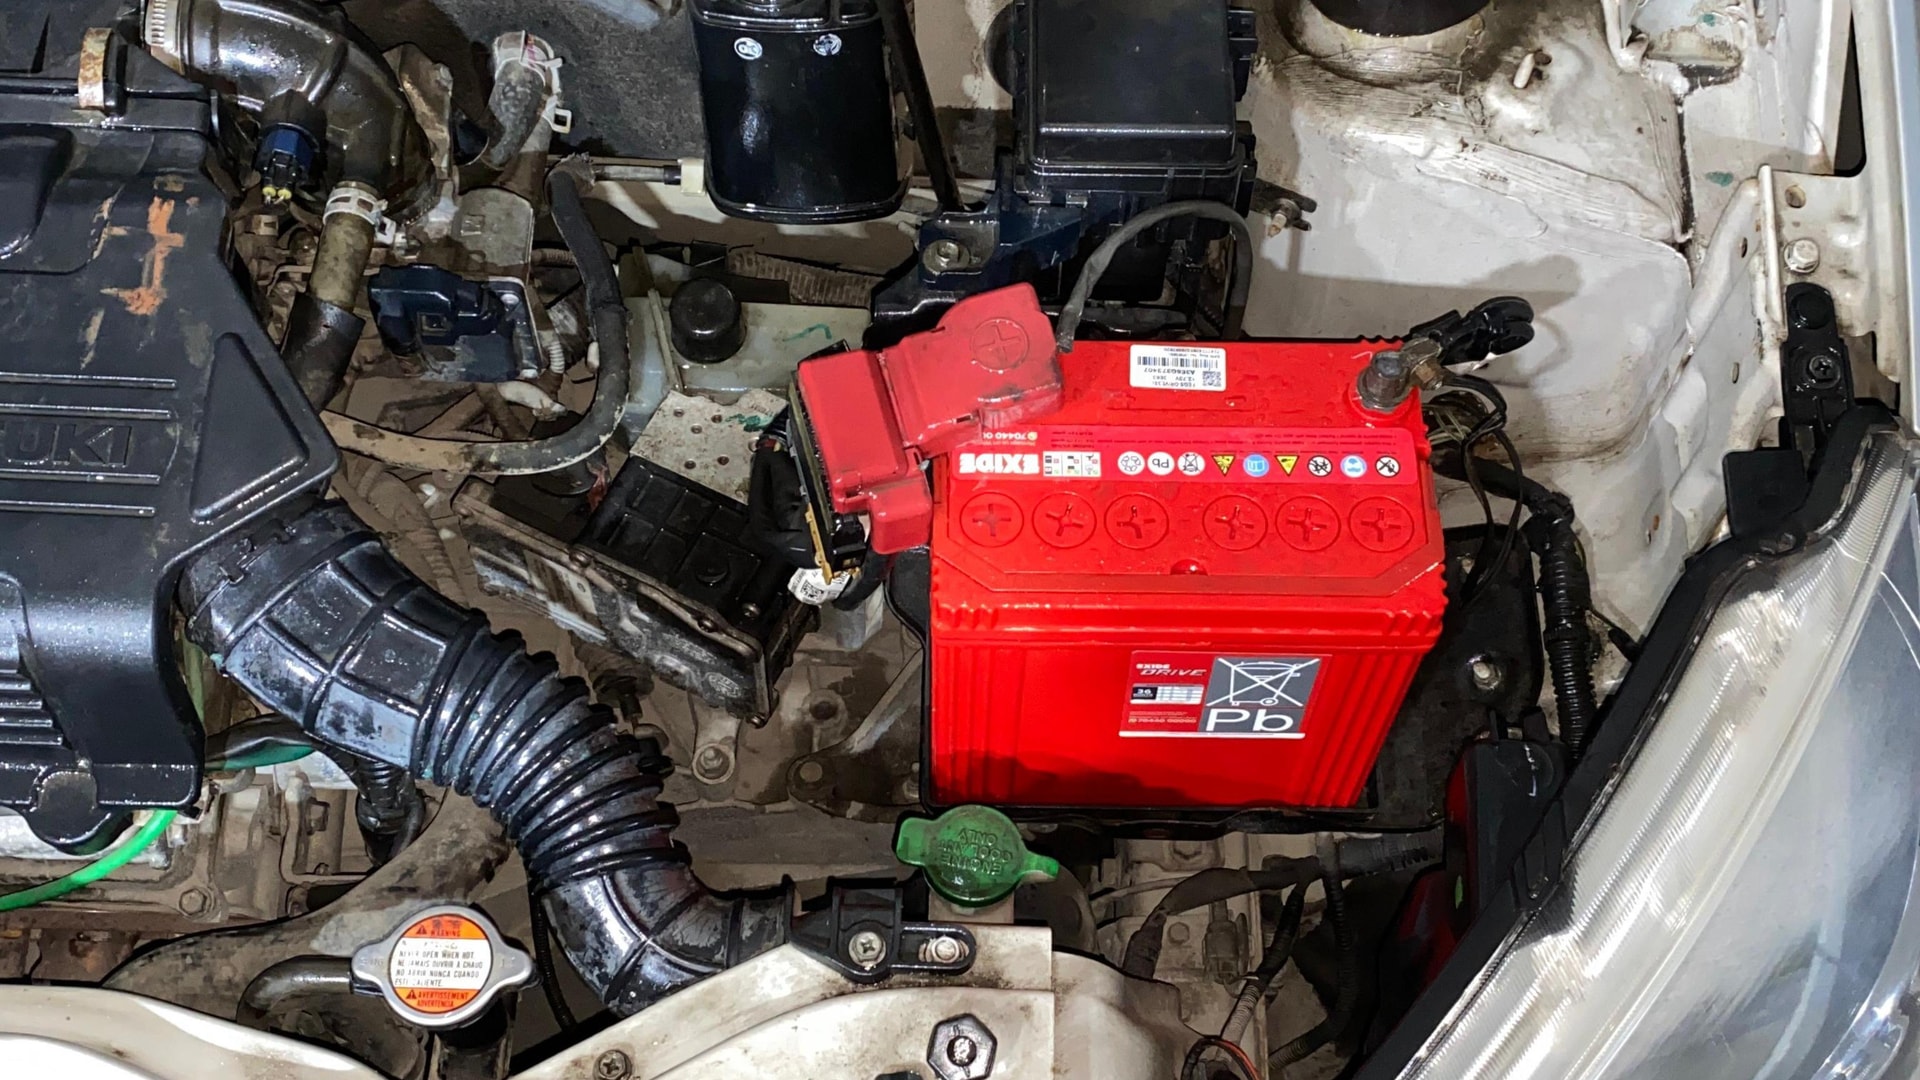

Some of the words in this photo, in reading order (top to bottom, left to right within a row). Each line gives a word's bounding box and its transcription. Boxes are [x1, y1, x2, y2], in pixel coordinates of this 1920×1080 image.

[0, 421, 132, 467] UKI
[959, 453, 1041, 475] EXIDE
[1152, 457, 1170, 470] Pb
[1205, 708, 1293, 732] Pb
[958, 828, 998, 847] ONLY
[937, 839, 1013, 864] COOLANT
[940, 852, 1003, 876] ENGINE
[453, 970, 480, 978] CUANDO
[418, 991, 470, 1000] AVERTISSEMENT
